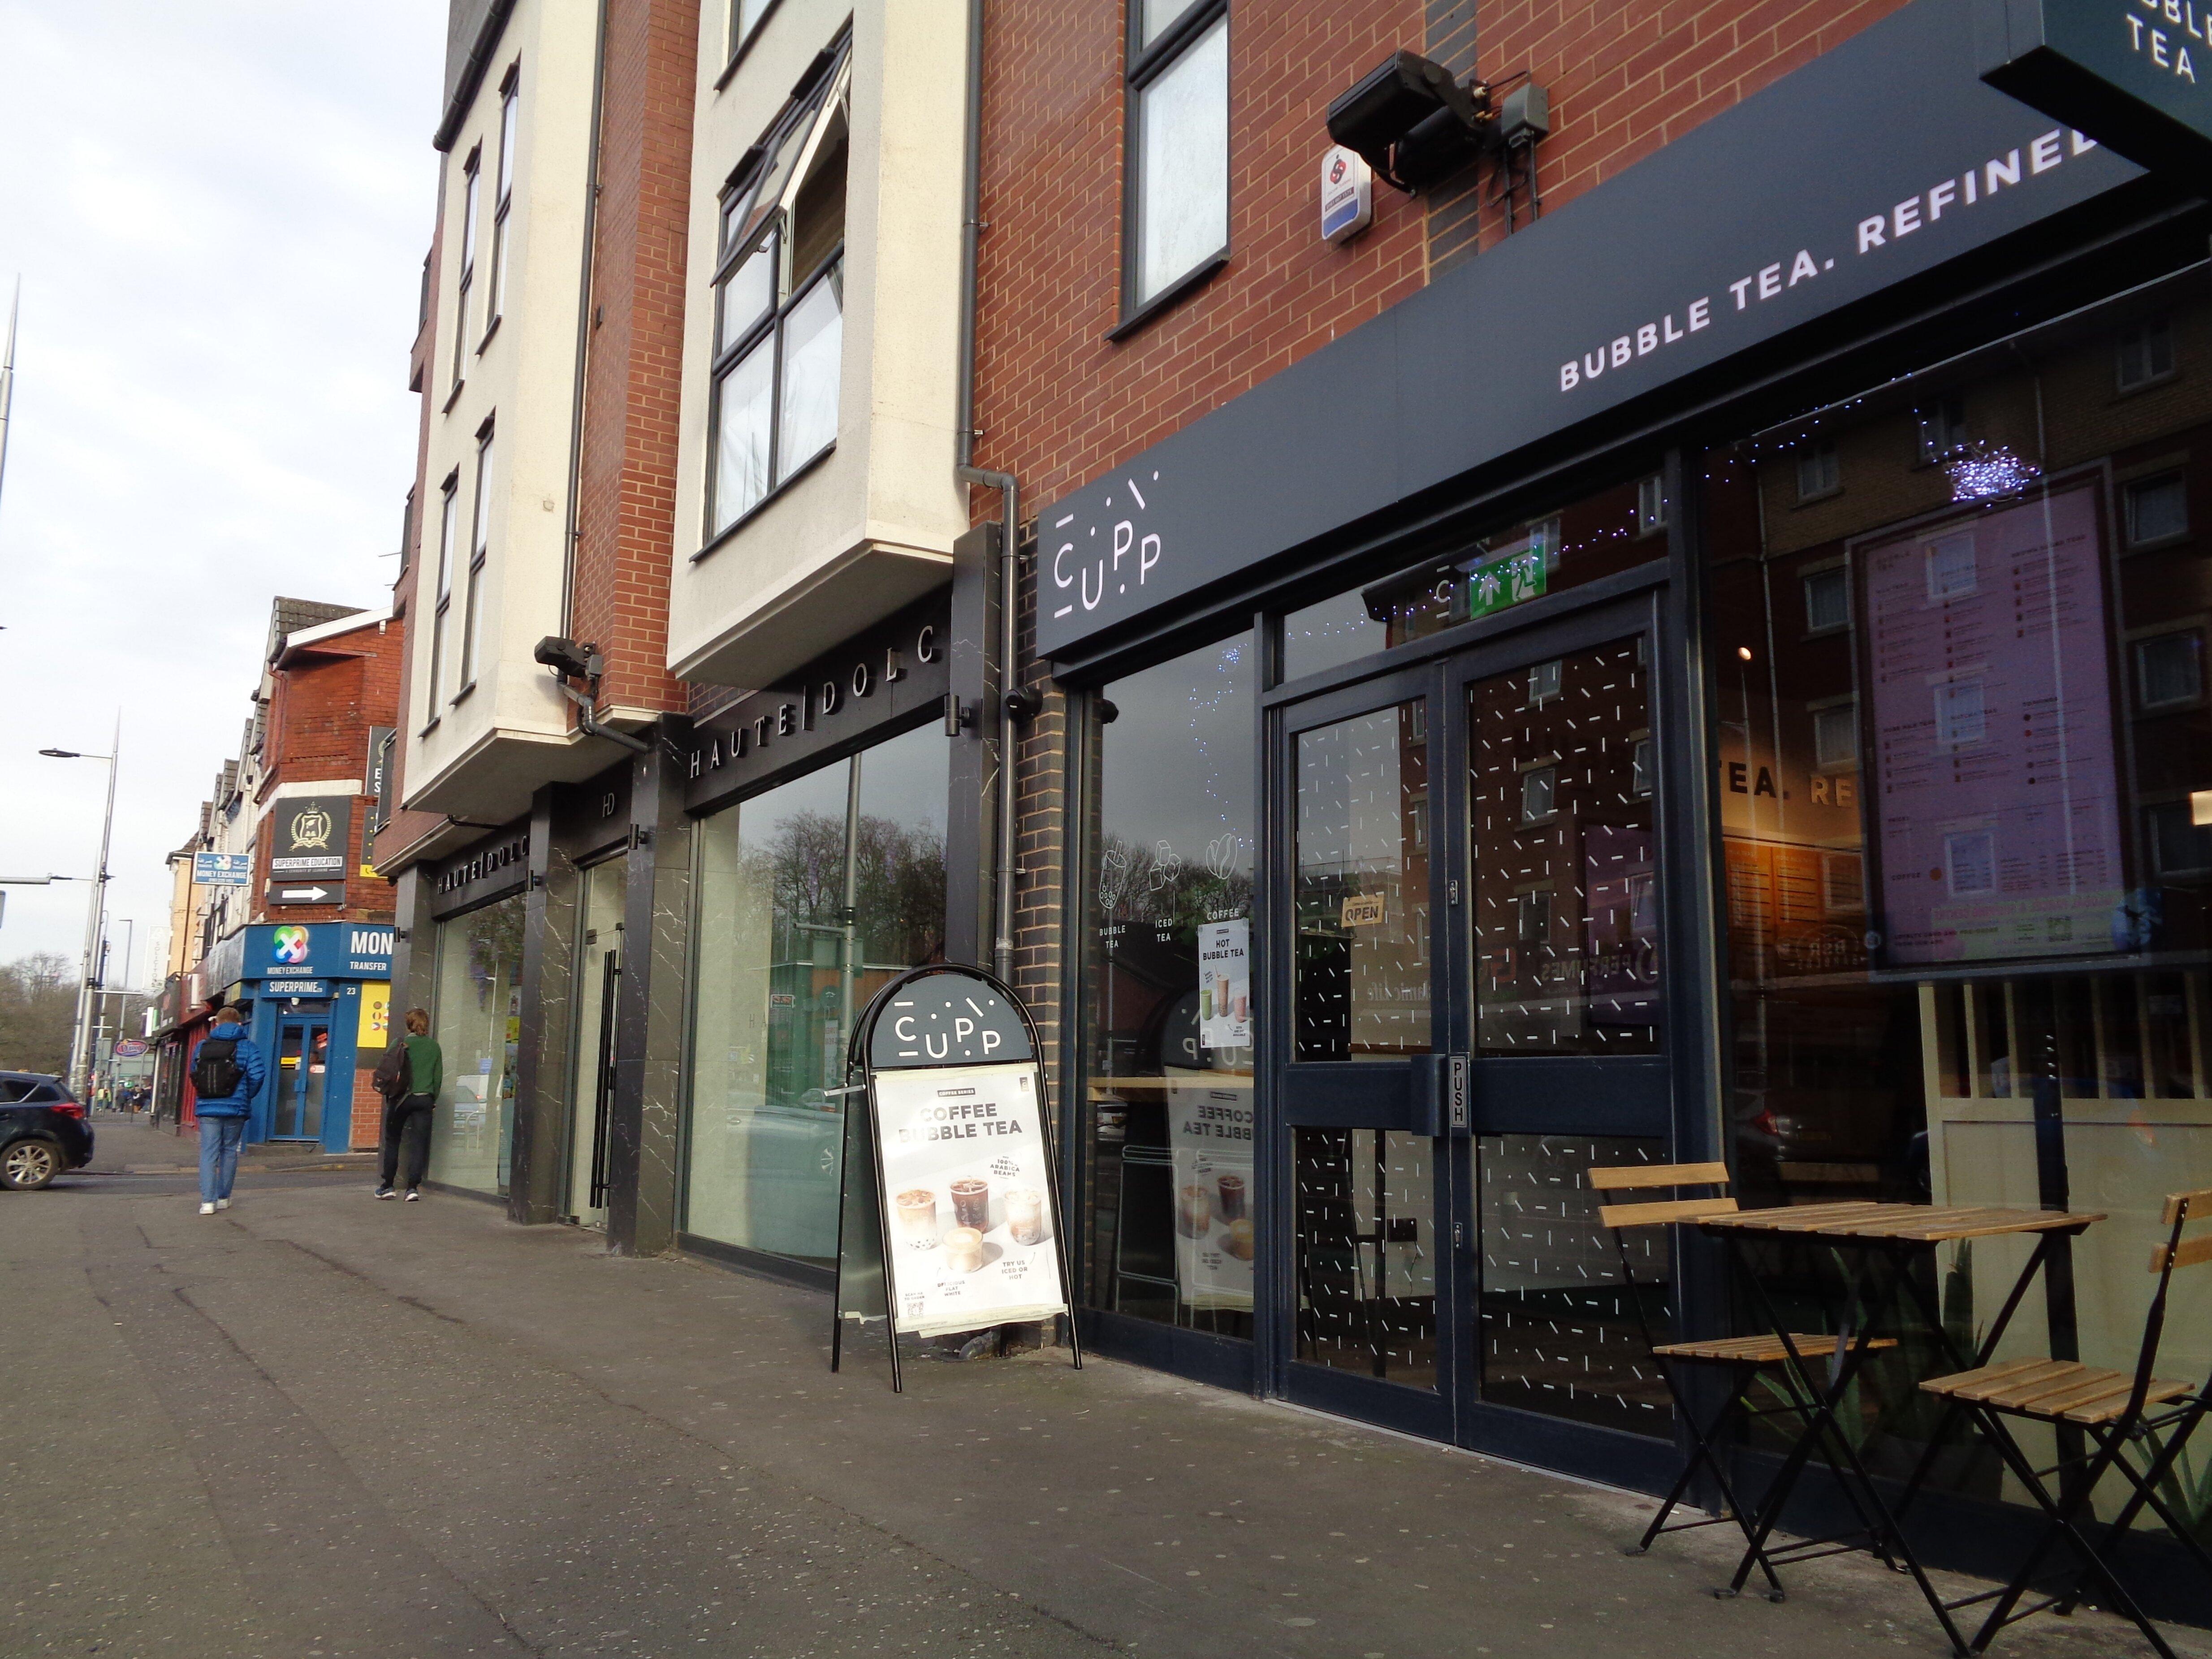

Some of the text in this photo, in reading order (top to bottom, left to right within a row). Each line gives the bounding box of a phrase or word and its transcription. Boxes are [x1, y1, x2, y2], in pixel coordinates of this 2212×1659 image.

[2126, 13, 2195, 84] TEA
[1560, 296, 1710, 392] BUBBLE
[1729, 248, 1835, 311] TEA.
[1054, 519, 1161, 611] CUPP
[690, 625, 933, 779] HAUTE DOLC
[1718, 759, 1789, 800] EA.
[487, 835, 531, 872] DOLC
[274, 858, 341, 867] SUPERPRIME EDUCATION
[217, 871, 247, 879] EXCHANGE
[1206, 908, 1239, 921] COFFEE
[1345, 906, 1378, 921] OPEN
[1155, 918, 1173, 929] ICED
[1099, 925, 1126, 937] BUBBLE
[1157, 933, 1171, 942] TEA
[1106, 940, 1119, 949] TEA
[1216, 938, 1230, 948] HOT
[1203, 948, 1244, 961] BUBBLE TEA
[267, 966, 314, 975] MONEY EXCHANGE
[350, 961, 387, 971] TRANSFER
[269, 981, 318, 993] SUPERPRIME
[895, 1015, 1002, 1059] CUPP
[1453, 1062, 1464, 1122] PUSH
[920, 1103, 998, 1122] COFFEE
[983, 1120, 1023, 1136] TEA
[989, 1164, 1020, 1172] ARABICA
